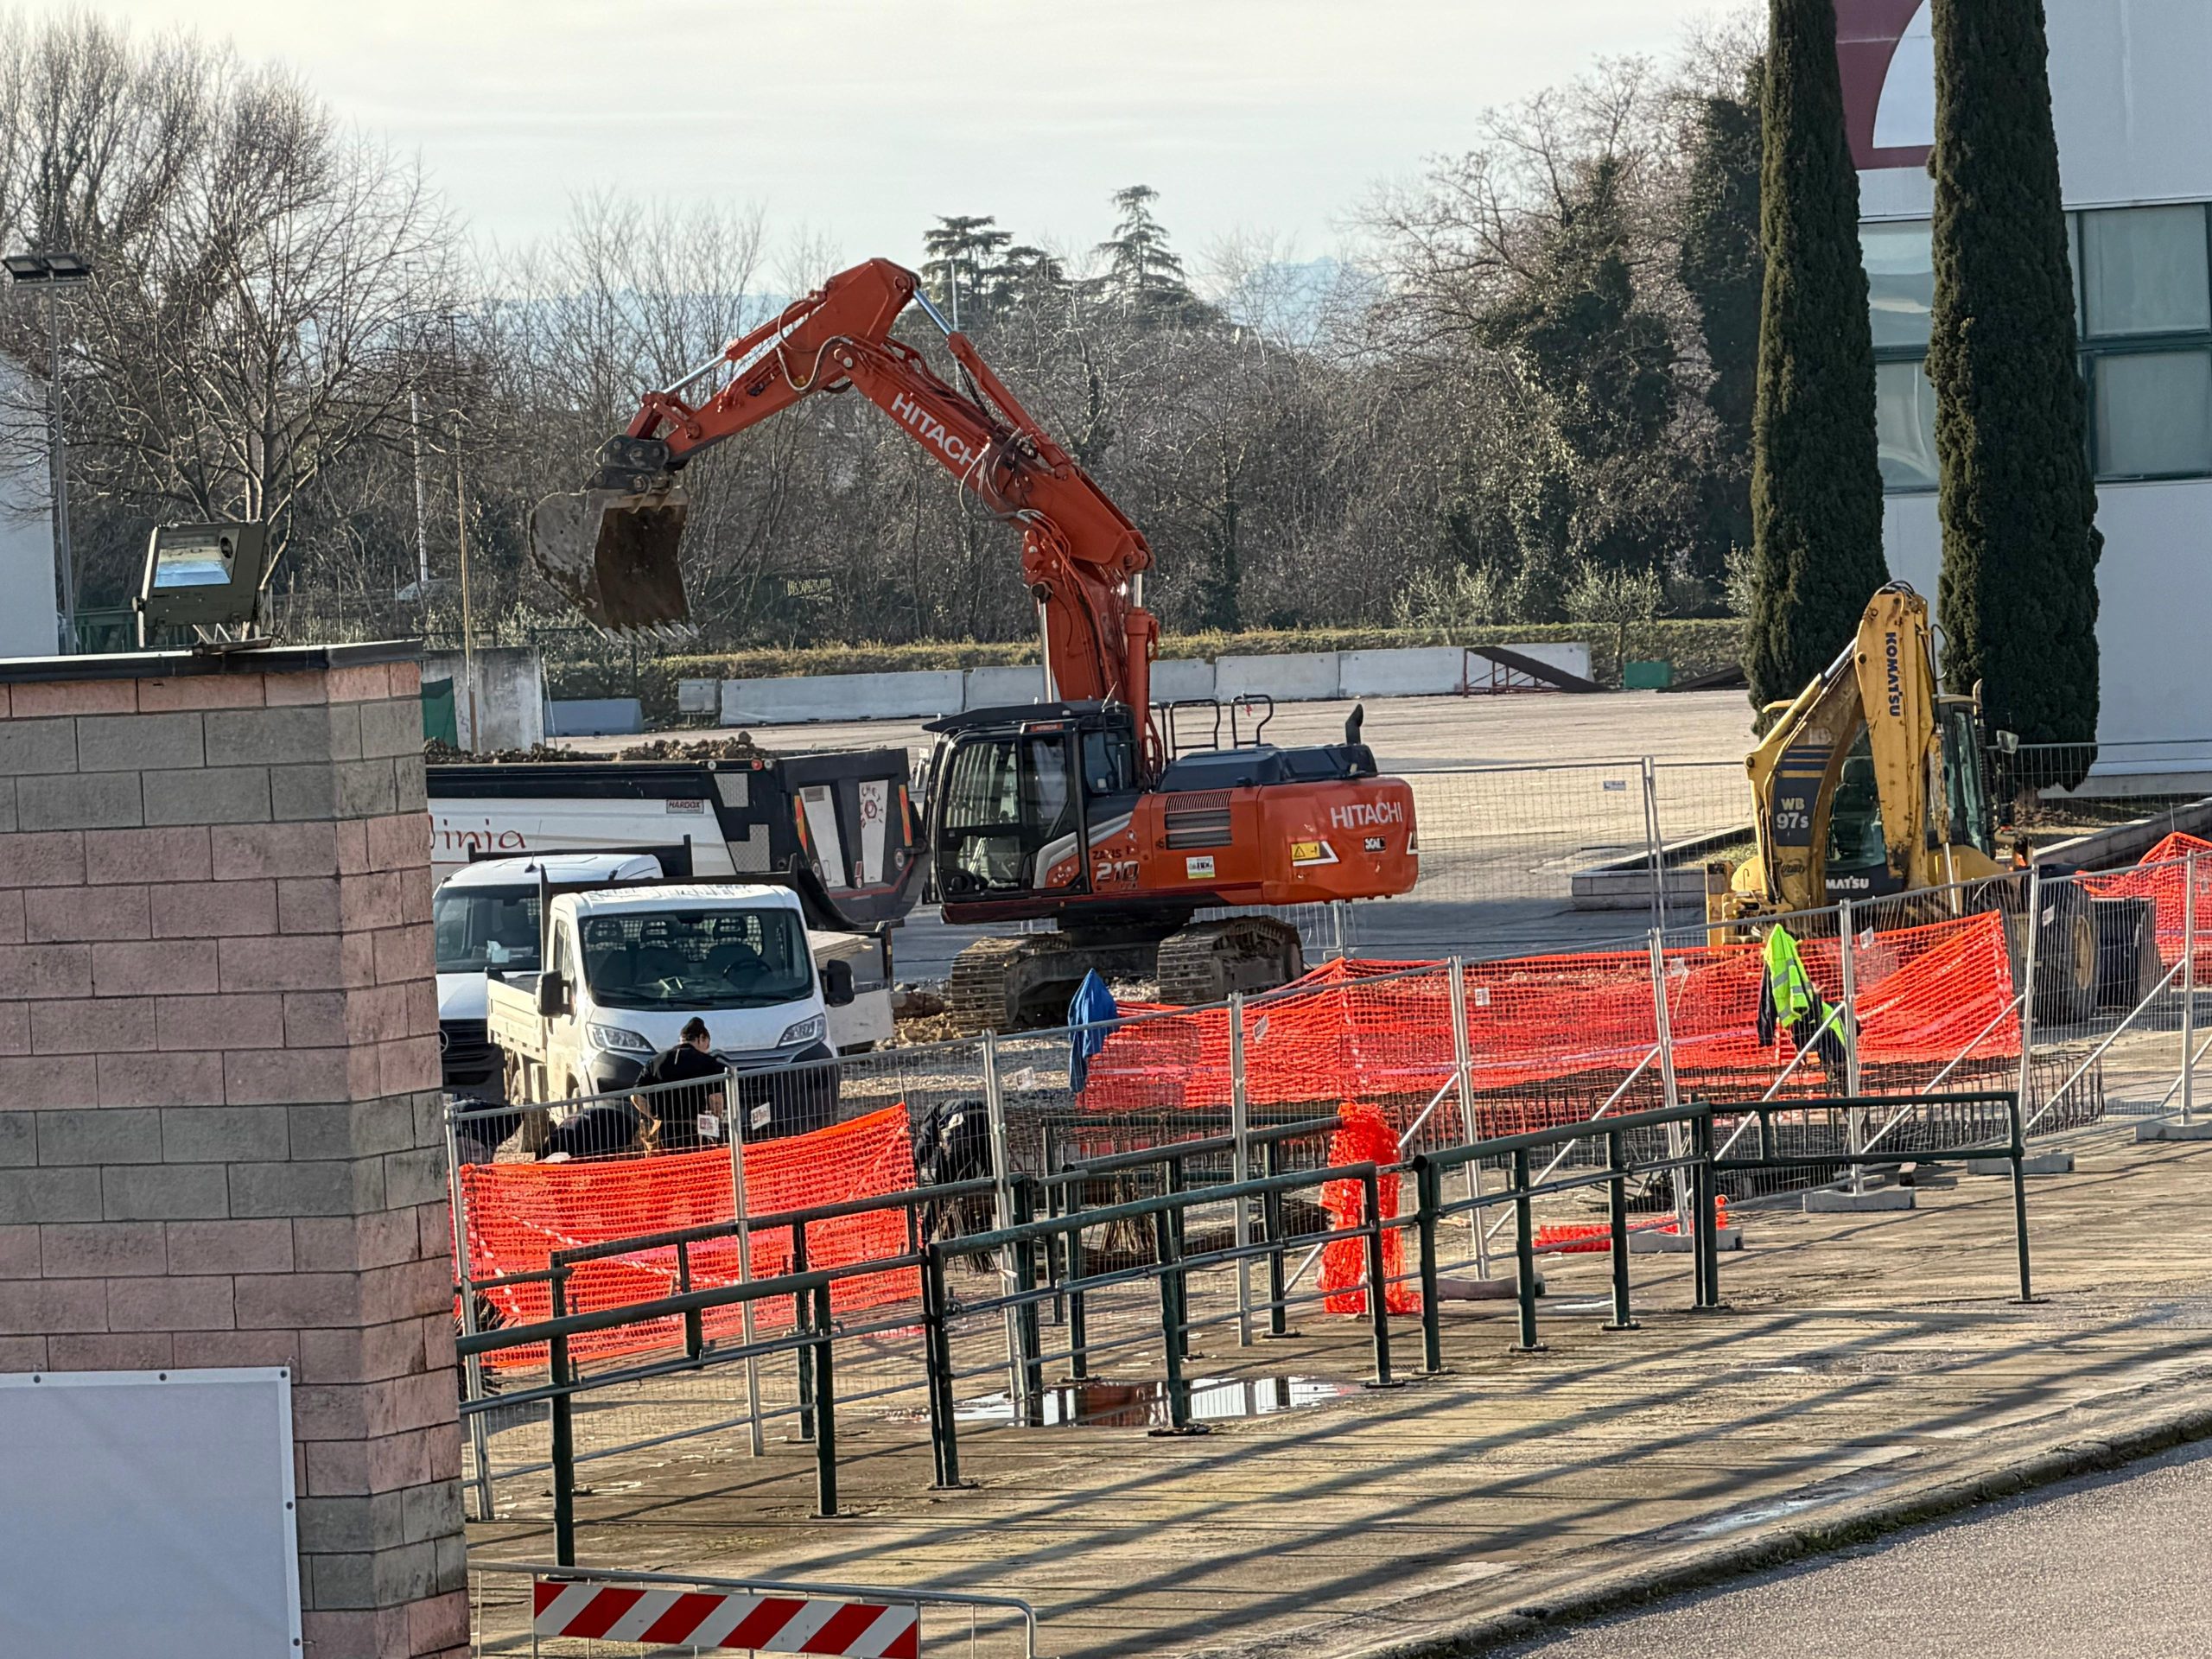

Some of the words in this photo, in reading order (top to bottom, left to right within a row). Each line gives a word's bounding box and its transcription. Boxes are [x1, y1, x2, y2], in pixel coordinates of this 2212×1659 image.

[891, 392, 982, 480] HITACH
[1885, 632, 1903, 716] KOMATSU
[1330, 802, 1403, 830] HITACHI
[1781, 798, 1805, 810] WB
[1096, 861, 1140, 884] 210
